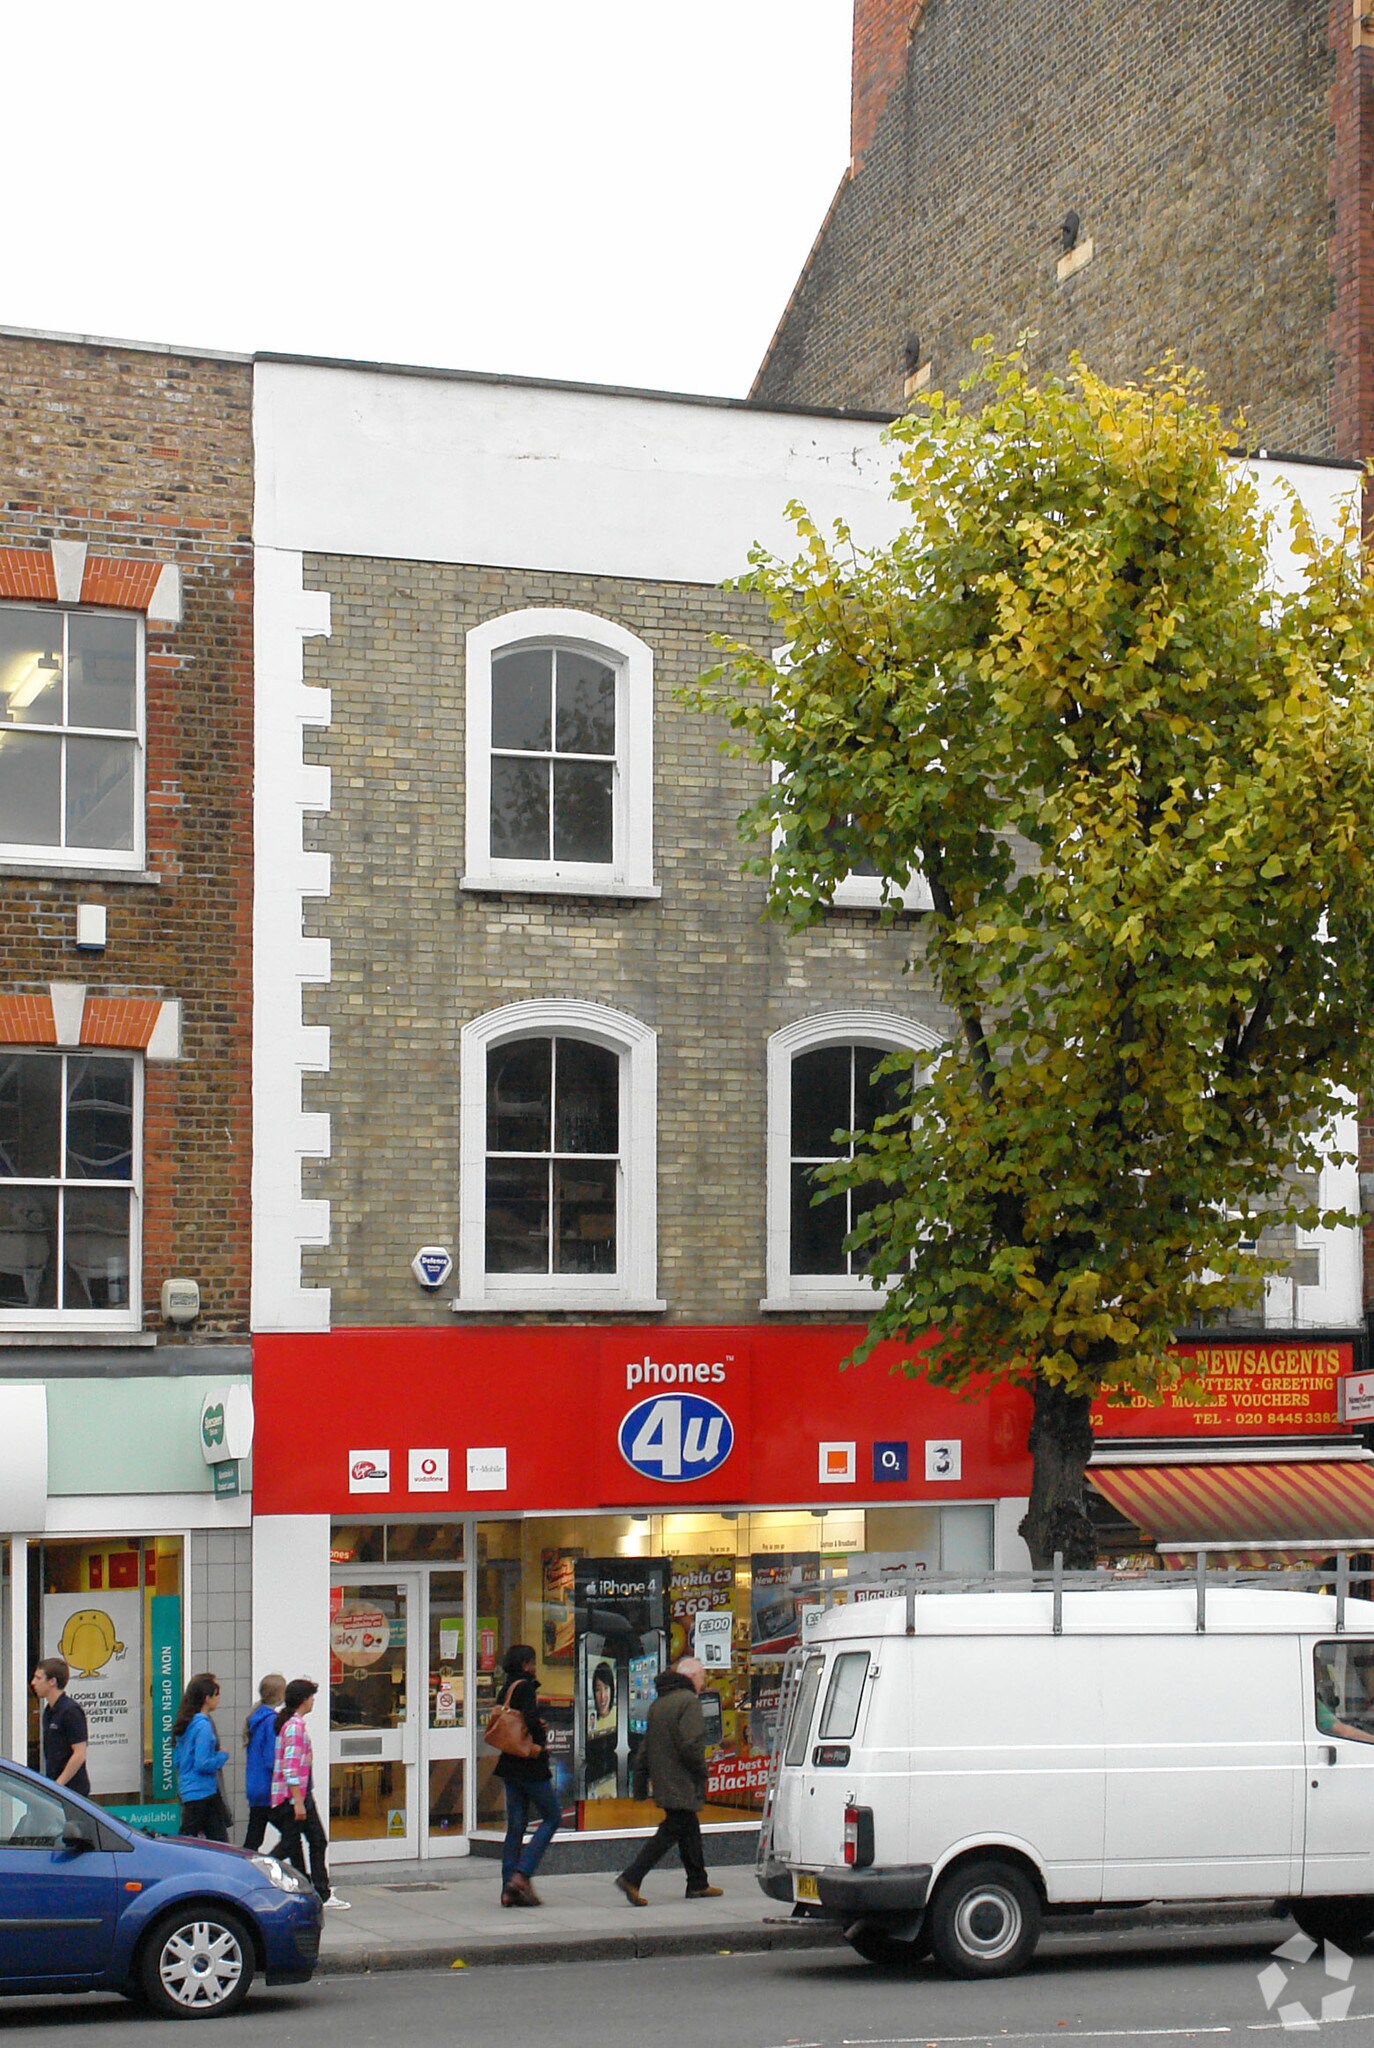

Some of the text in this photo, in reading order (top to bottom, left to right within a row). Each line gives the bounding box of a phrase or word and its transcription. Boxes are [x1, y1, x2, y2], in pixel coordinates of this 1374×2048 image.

[1195, 1349, 1340, 1376] NEWSAGENTS
[626, 1356, 726, 1390] phones
[1190, 1378, 1253, 1391] OTTERY
[1261, 1377, 1334, 1391] GREETING
[1232, 1393, 1310, 1406] VOUCHERS
[1193, 1413, 1222, 1424] TEL
[1235, 1413, 1263, 1424] 020
[1267, 1412, 1303, 1424] 8445
[1305, 1412, 1338, 1423] 3382
[599, 1578, 656, 1595] iPhone 4
[671, 1569, 732, 1587] Nokia C3
[699, 1617, 730, 1632] £300
[90, 1715, 114, 1724] OFFER
[161, 1646, 173, 1791] NOW OPEN ON SUNDAYS
[718, 1762, 735, 1774] For
[738, 1757, 761, 1770] best
[708, 1769, 769, 1793] BlackB
[129, 1812, 177, 1823] Available
